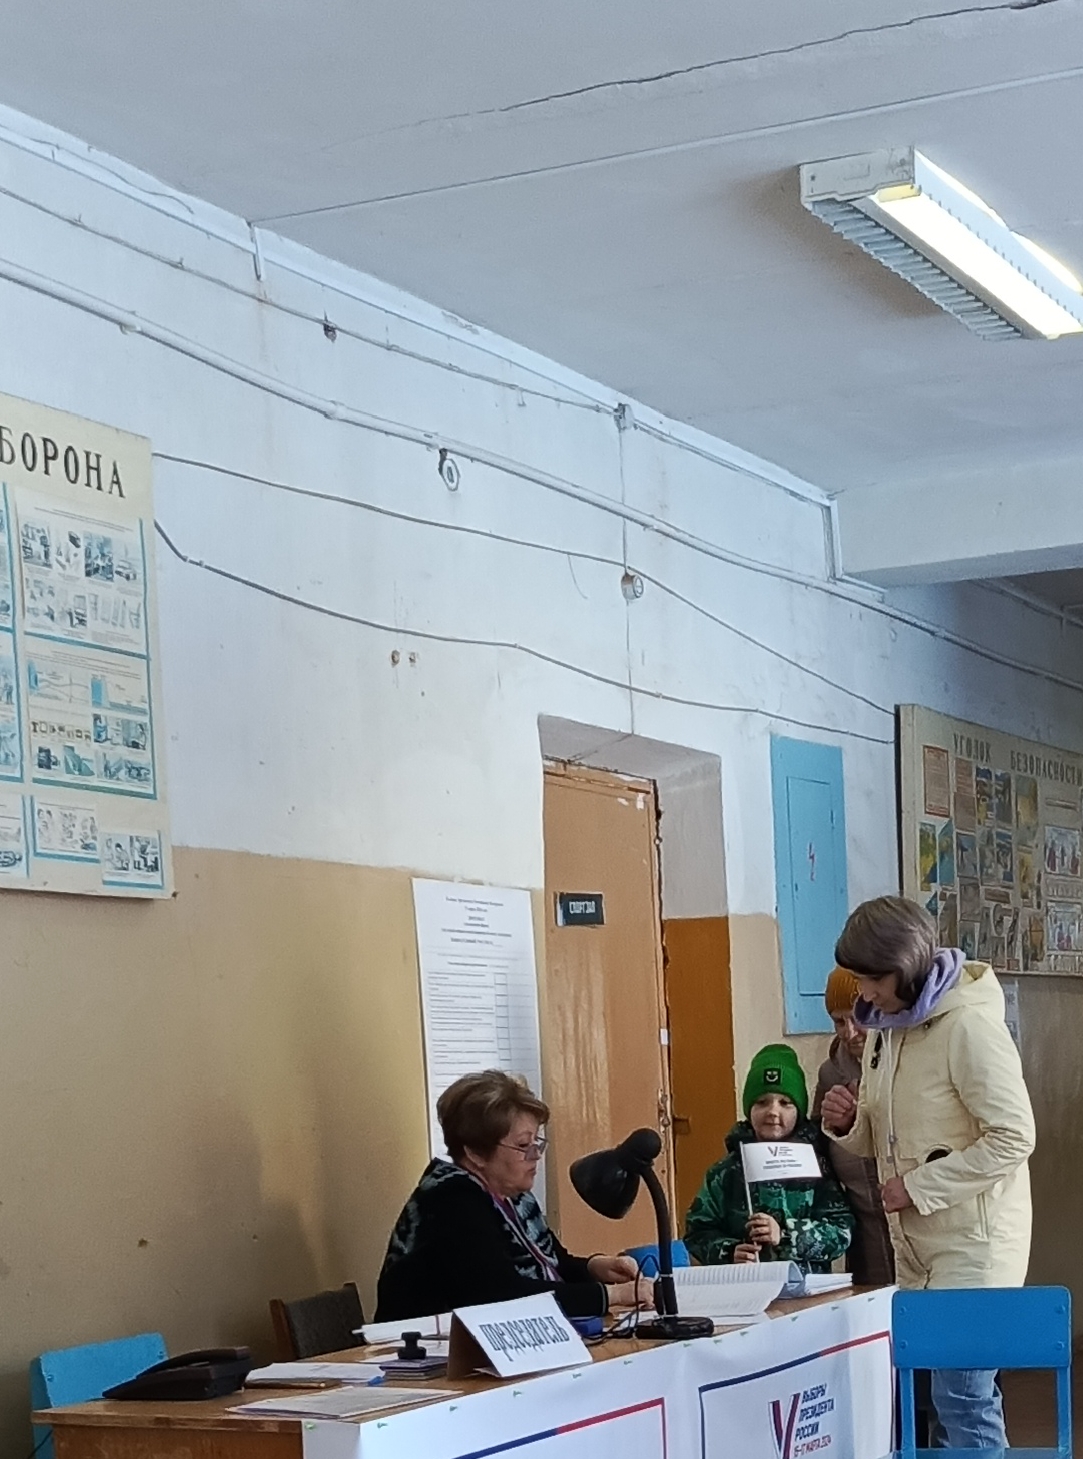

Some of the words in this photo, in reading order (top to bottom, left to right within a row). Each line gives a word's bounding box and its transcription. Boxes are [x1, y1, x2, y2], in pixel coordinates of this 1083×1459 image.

[0, 425, 126, 499] БОРОНА
[953, 732, 991, 763] УГОЛОК
[1010, 749, 1083, 788] БЕЗОПАСНОСТИ
[478, 1316, 570, 1362] председатель
[799, 1398, 835, 1422] ПРЕЗИДЕНТА
[802, 1382, 827, 1404] ВЫБОРЫ
[794, 1421, 820, 1442] РОССИИ
